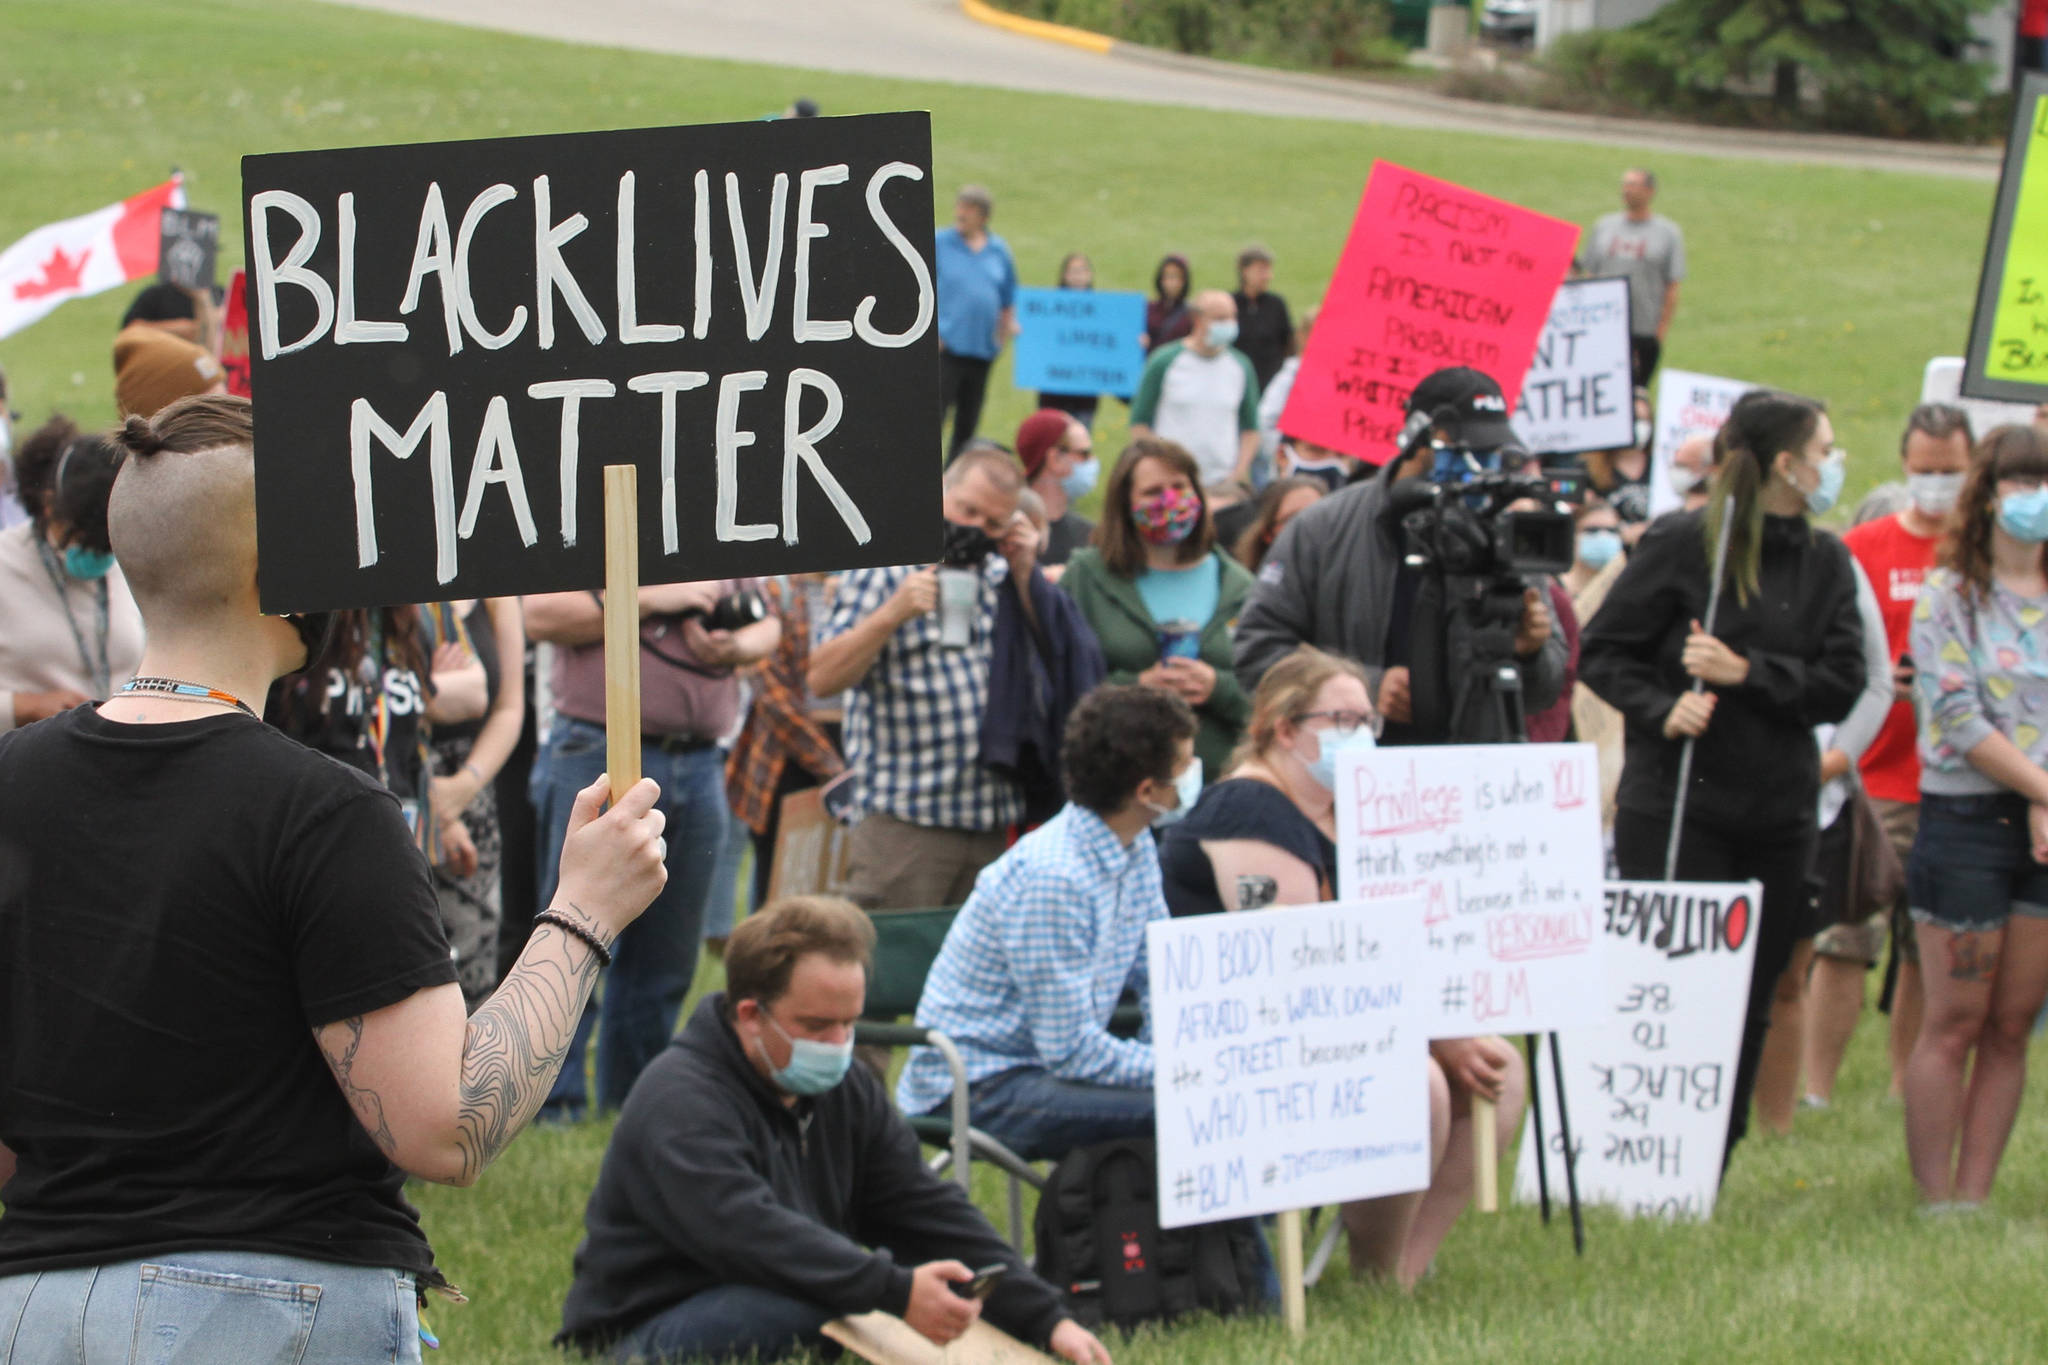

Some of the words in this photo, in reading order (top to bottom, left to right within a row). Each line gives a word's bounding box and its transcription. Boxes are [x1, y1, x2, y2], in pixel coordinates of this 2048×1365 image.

[1390, 183, 1511, 237] RACISM
[617, 160, 935, 349] LIVES
[1399, 231, 1431, 254] IS
[1449, 239, 1499, 267] NOT
[1025, 300, 1096, 318] BLACK
[1366, 265, 1514, 327] AMERICAN
[1384, 316, 1500, 366] PROBLEM
[1516, 371, 1616, 423] ATHE
[350, 367, 872, 585] MATTER
[1353, 760, 1463, 834] Privilege
[1475, 778, 1495, 812] is
[1501, 768, 1544, 804] when
[1356, 836, 1406, 879] think
[1456, 880, 1512, 915] because
[1291, 919, 1347, 971] should
[1356, 928, 1381, 963] be
[1486, 904, 1593, 956] PERSONALLY
[1175, 999, 1249, 1048] AFRAID
[1259, 996, 1281, 1026] to
[1286, 982, 1338, 1024] WALK
[1344, 982, 1403, 1017] DOWN
[1441, 967, 1533, 1022] #BLM
[1616, 983, 1673, 1013] BE
[1172, 1060, 1202, 1092] the
[1214, 1034, 1289, 1086] STREET
[1299, 1035, 1368, 1068] because
[1375, 1024, 1398, 1052] of
[1185, 1091, 1248, 1148] WHO
[1255, 1079, 1317, 1129] THEY
[1331, 1075, 1375, 1119] ARE
[1591, 1061, 1723, 1113] BLACK
[1611, 1097, 1649, 1128] be
[1604, 1133, 1682, 1176] Have
[1175, 1154, 1250, 1214] #BLM
